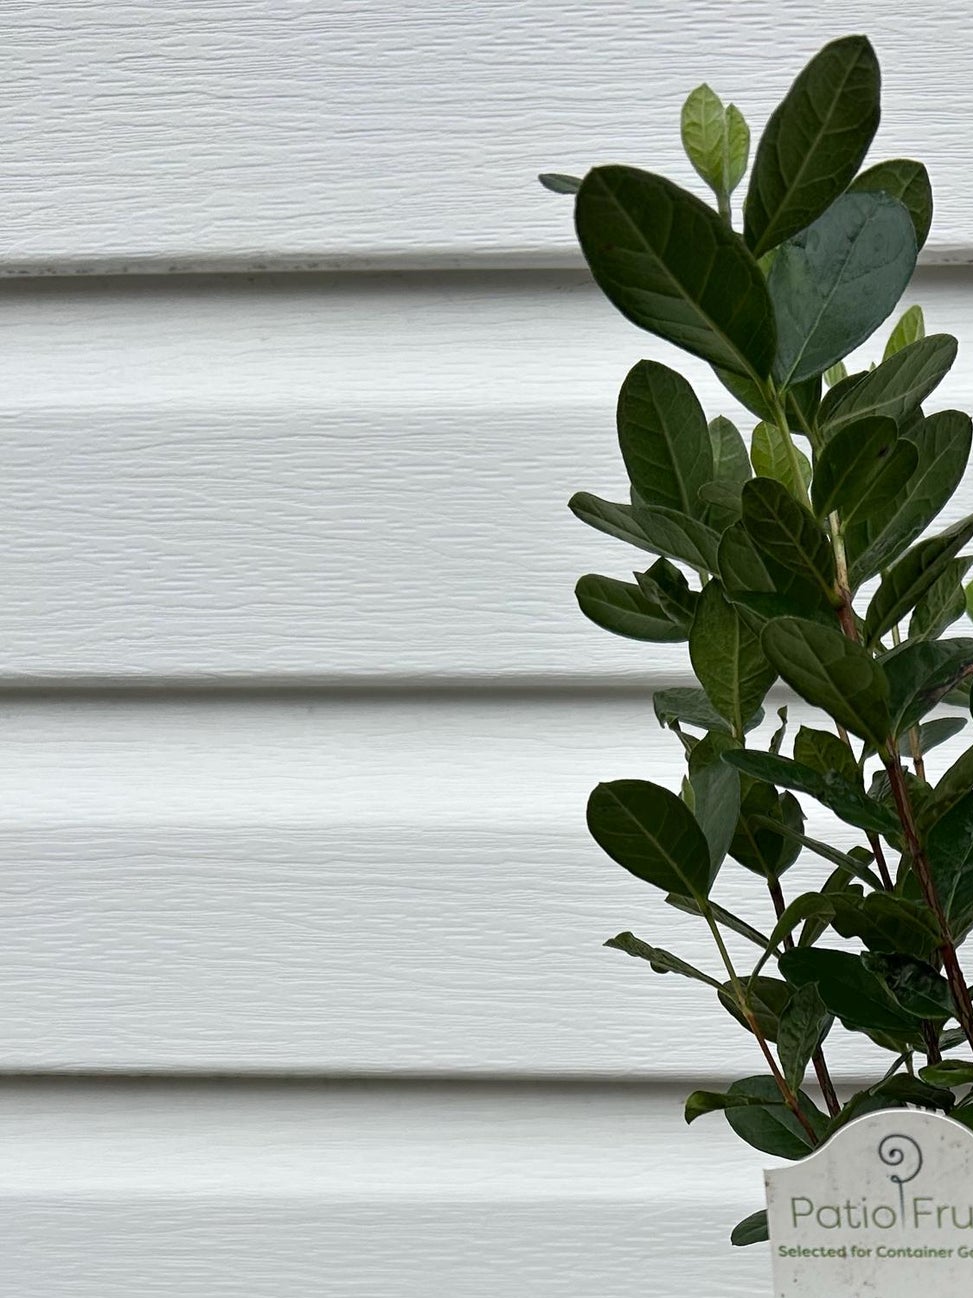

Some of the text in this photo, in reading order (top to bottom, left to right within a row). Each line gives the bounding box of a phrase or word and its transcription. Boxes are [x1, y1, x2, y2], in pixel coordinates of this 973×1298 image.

[791, 1197, 897, 1229] Patio
[778, 1245, 847, 1258] Selected
[851, 1246, 872, 1258] for
[876, 1246, 954, 1259] Container
